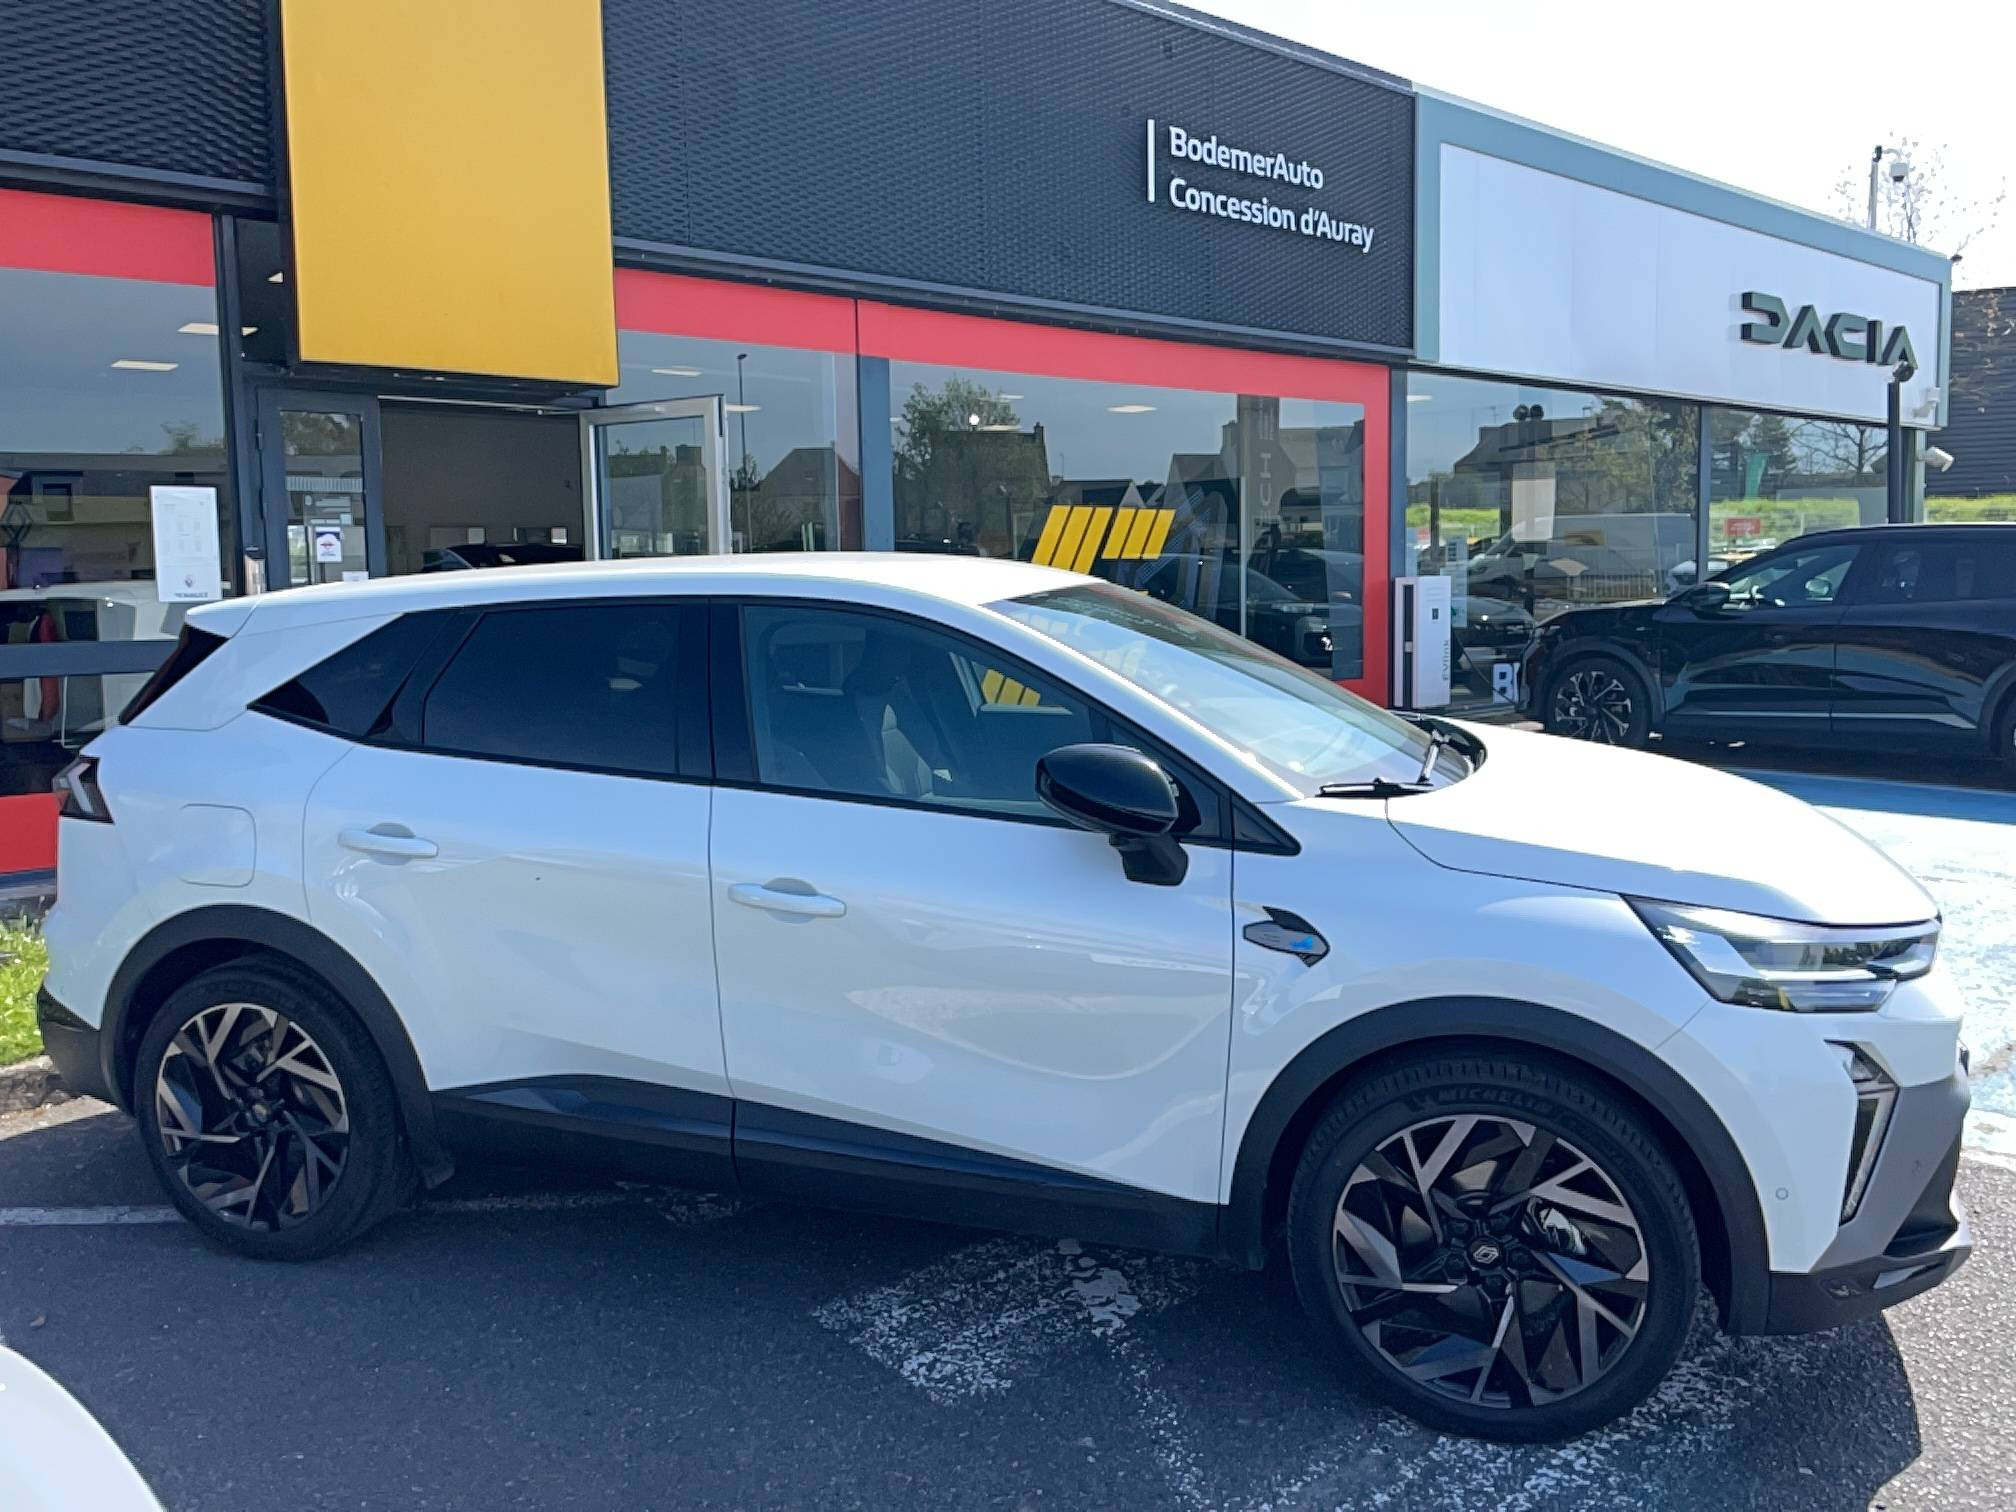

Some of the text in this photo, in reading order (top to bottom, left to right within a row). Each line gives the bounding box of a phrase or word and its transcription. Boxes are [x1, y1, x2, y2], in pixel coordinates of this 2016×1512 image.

[1169, 125, 1324, 190] BodemerAuto
[1169, 177, 1375, 254] Concession d'Auray
[1741, 291, 1918, 369] DACIA
